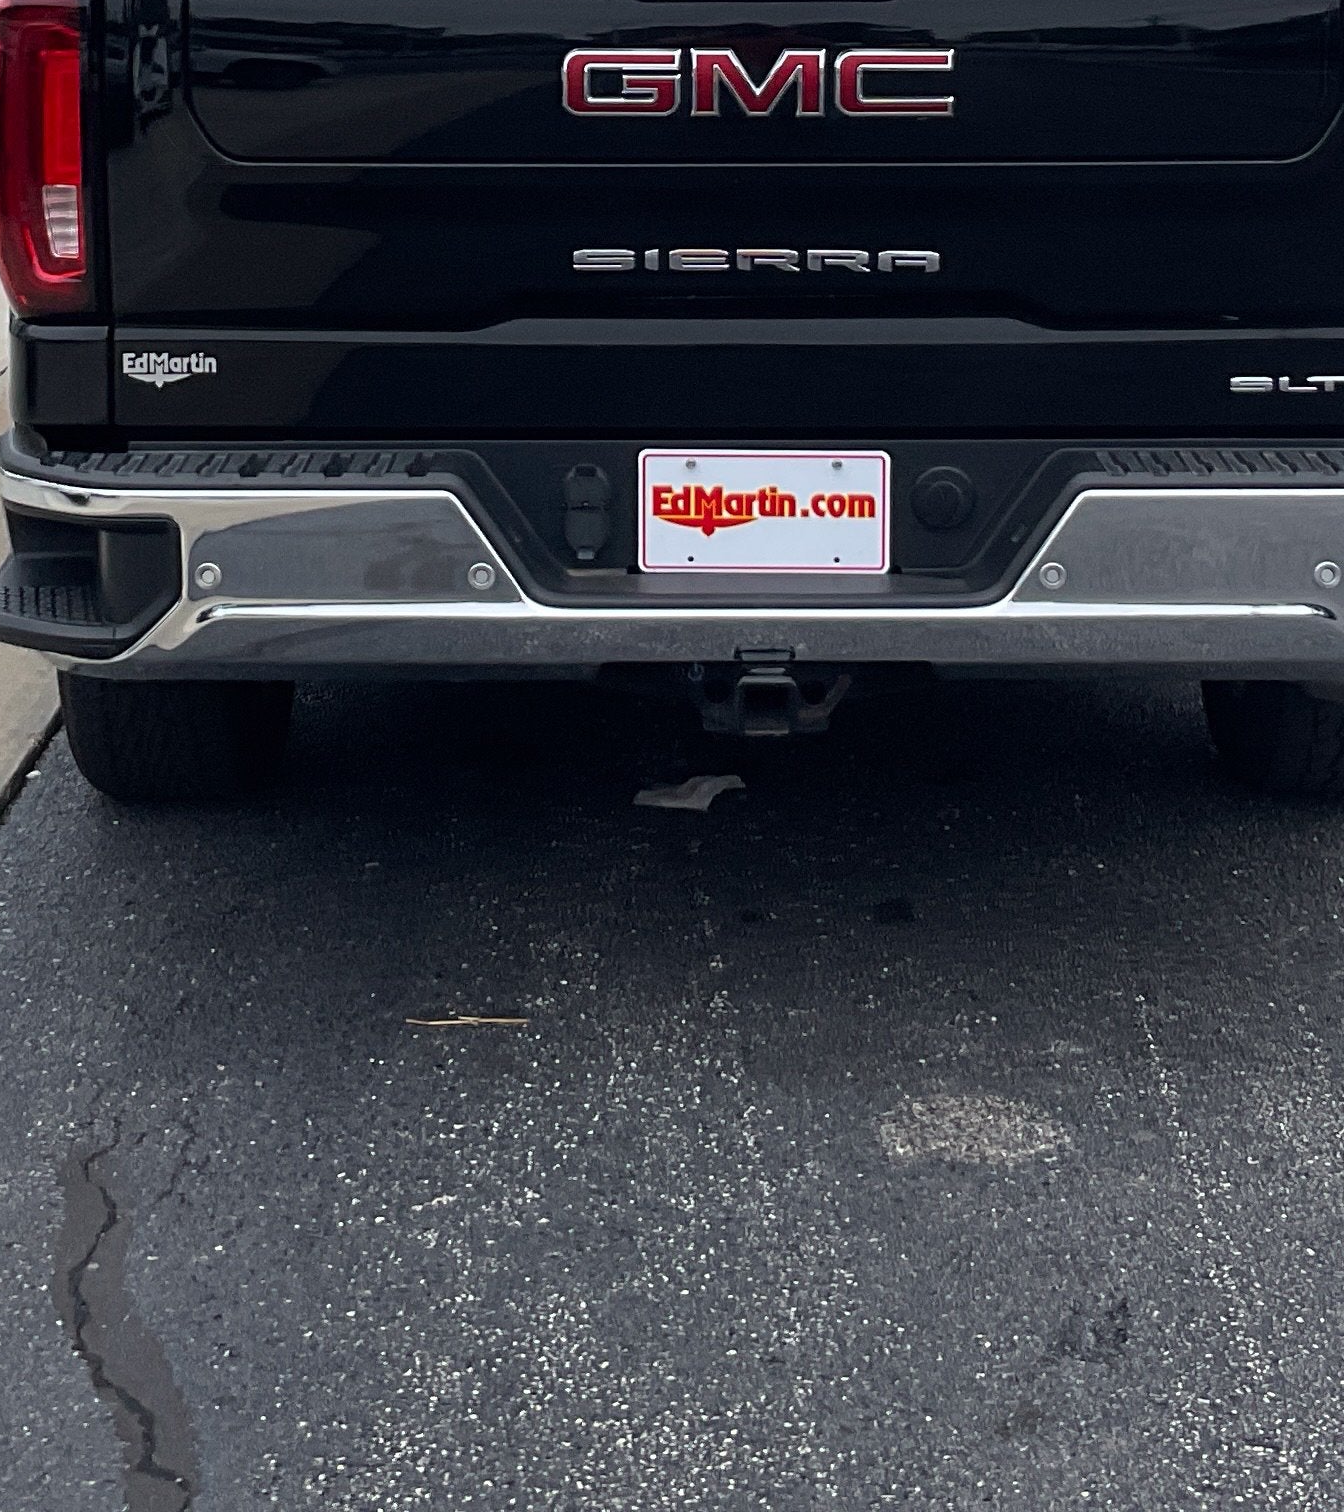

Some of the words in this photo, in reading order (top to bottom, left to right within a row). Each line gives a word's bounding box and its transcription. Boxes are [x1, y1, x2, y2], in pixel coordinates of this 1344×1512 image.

[563, 48, 955, 116] GMC
[573, 249, 940, 272] SIERRA
[122, 352, 217, 377] EdMartin
[652, 484, 876, 522] EdMartin.com
